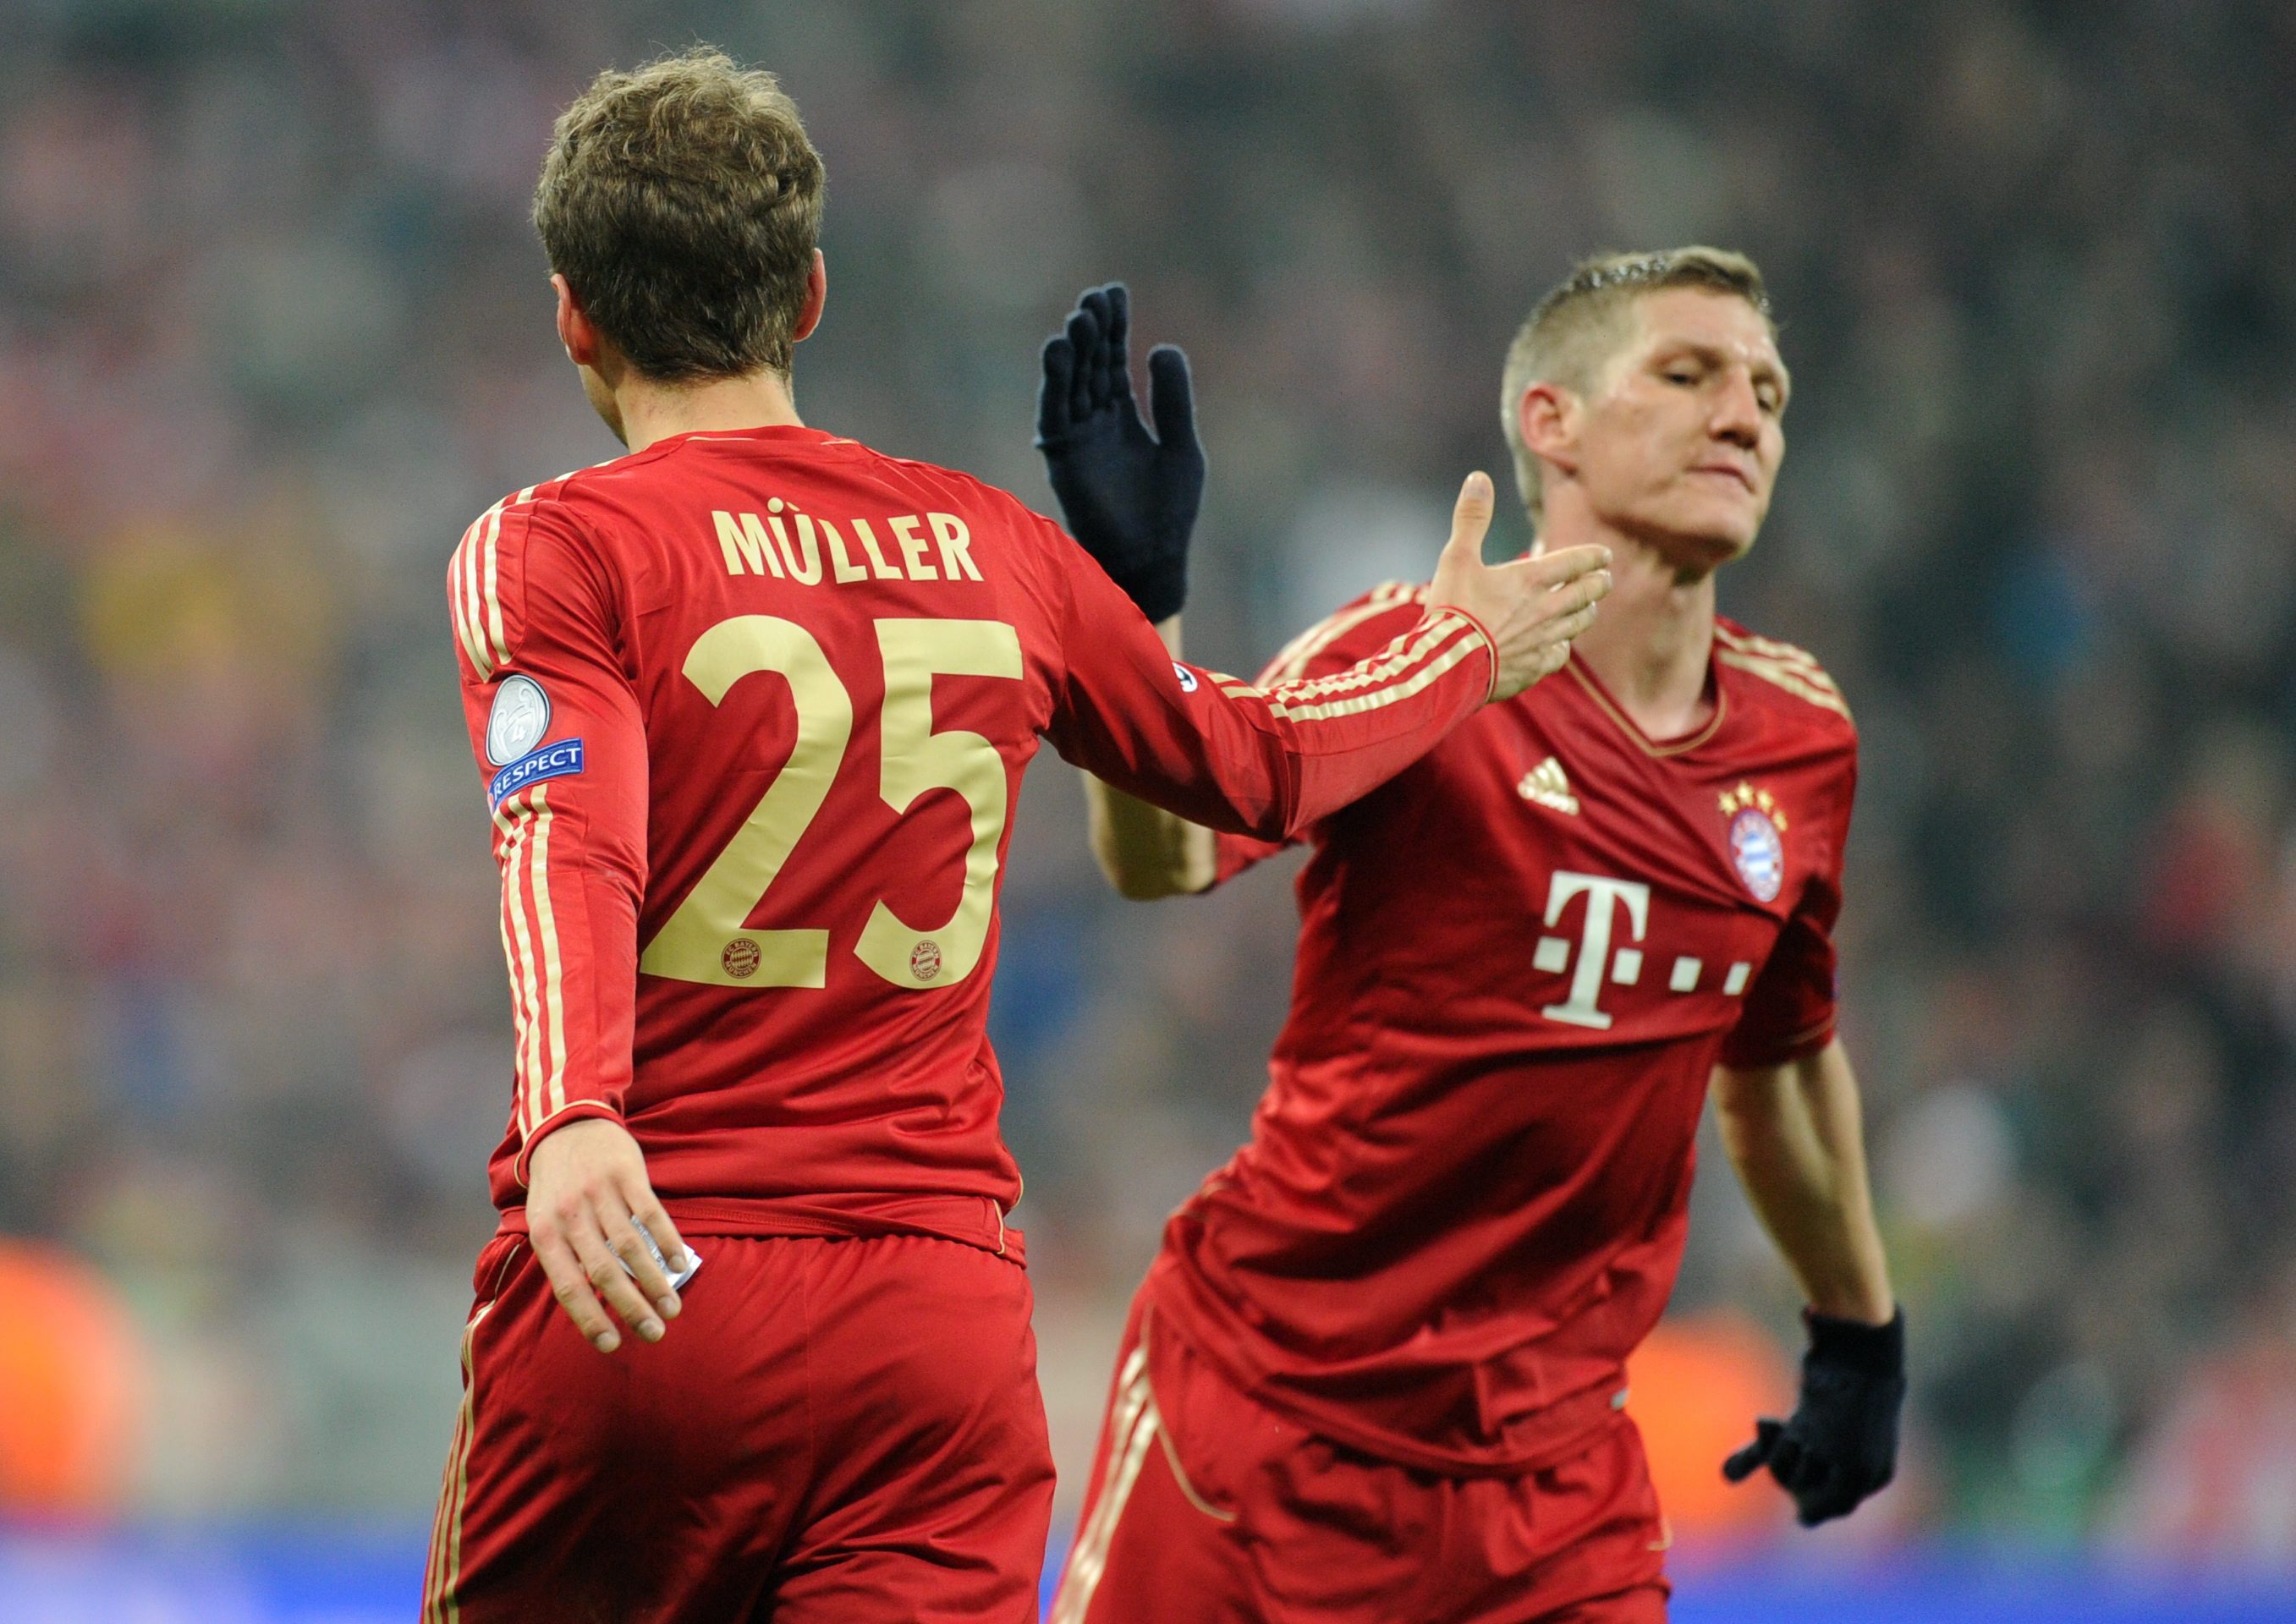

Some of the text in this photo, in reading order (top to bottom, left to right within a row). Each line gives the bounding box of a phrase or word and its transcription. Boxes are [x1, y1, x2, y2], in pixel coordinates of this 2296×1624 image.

[711, 497, 985, 586] MÜLLER
[493, 748, 581, 801] RESPECT
[640, 614, 1024, 989] 25
